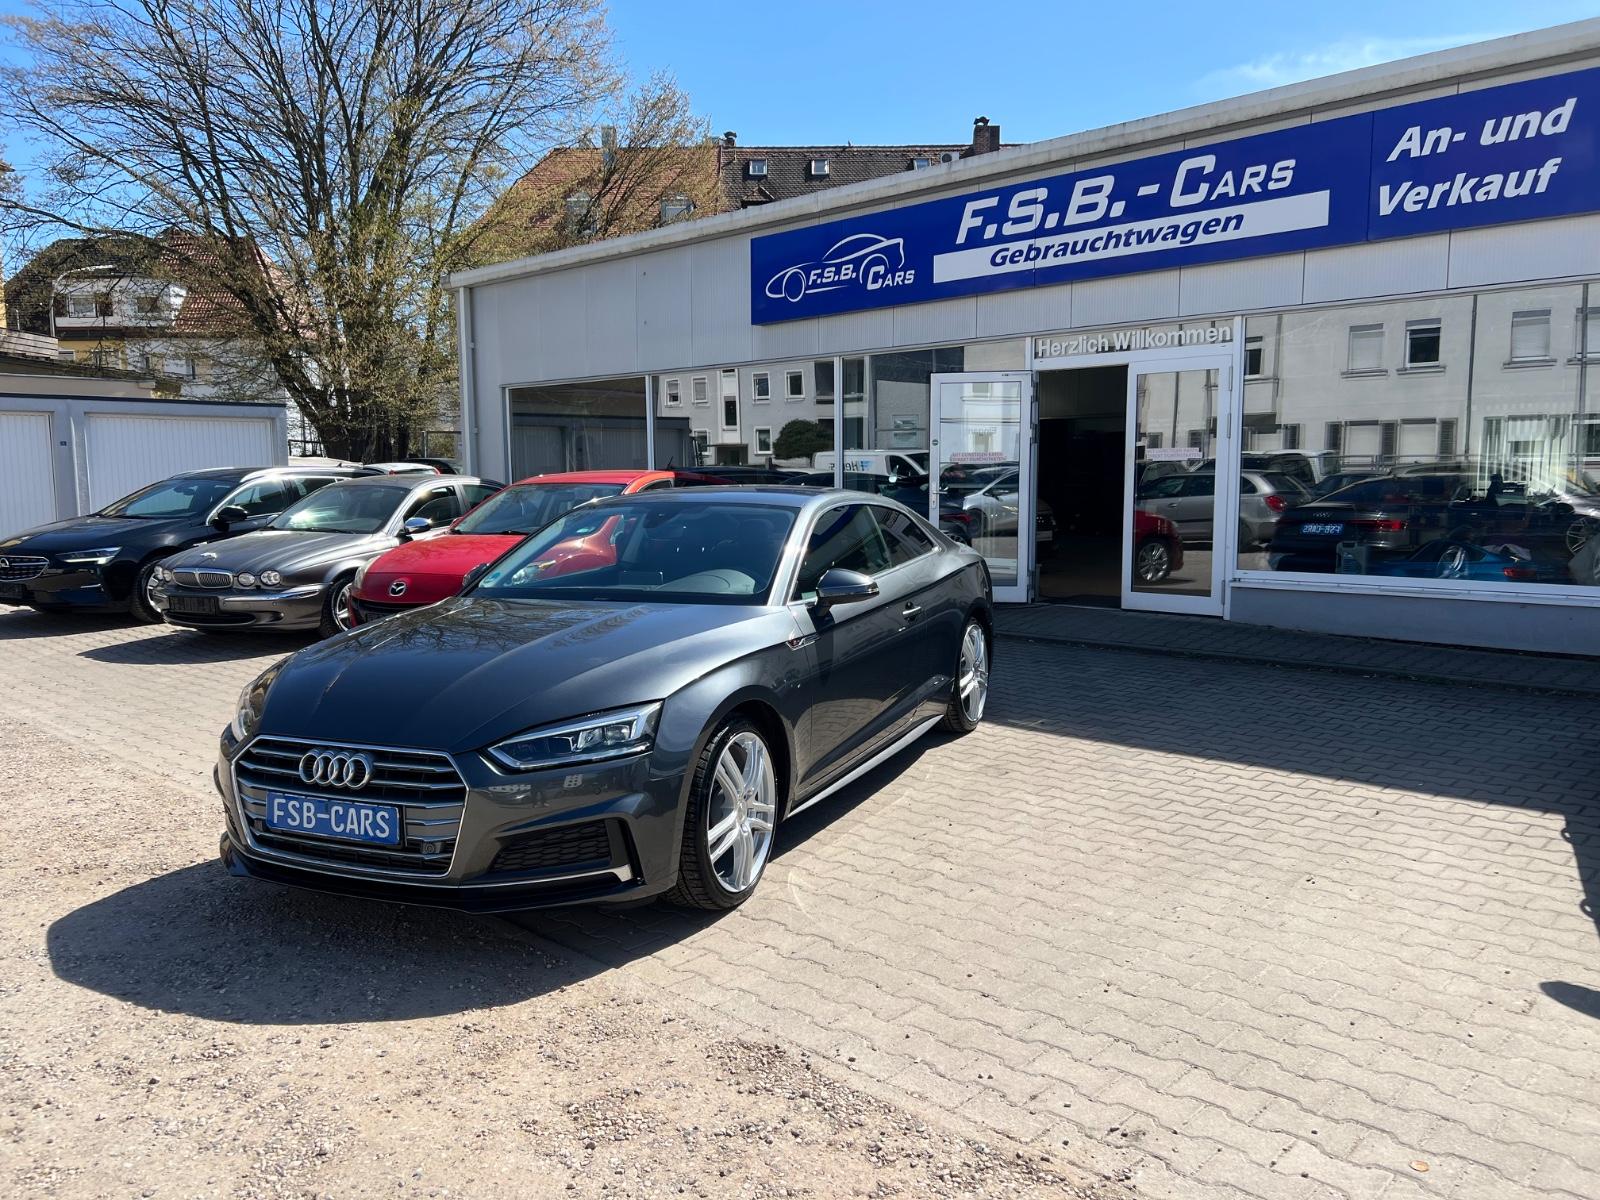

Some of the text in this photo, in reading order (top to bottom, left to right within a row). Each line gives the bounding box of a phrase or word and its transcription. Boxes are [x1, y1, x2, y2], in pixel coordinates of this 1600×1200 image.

[1386, 97, 1577, 162] An- und
[1379, 157, 1562, 216] Verkauf
[989, 214, 1244, 267] Gebrauchtwagen
[808, 264, 857, 286] F.S.B.
[1038, 326, 1231, 357] Herzlich Willkommen
[273, 798, 391, 838] FSB-CARS
